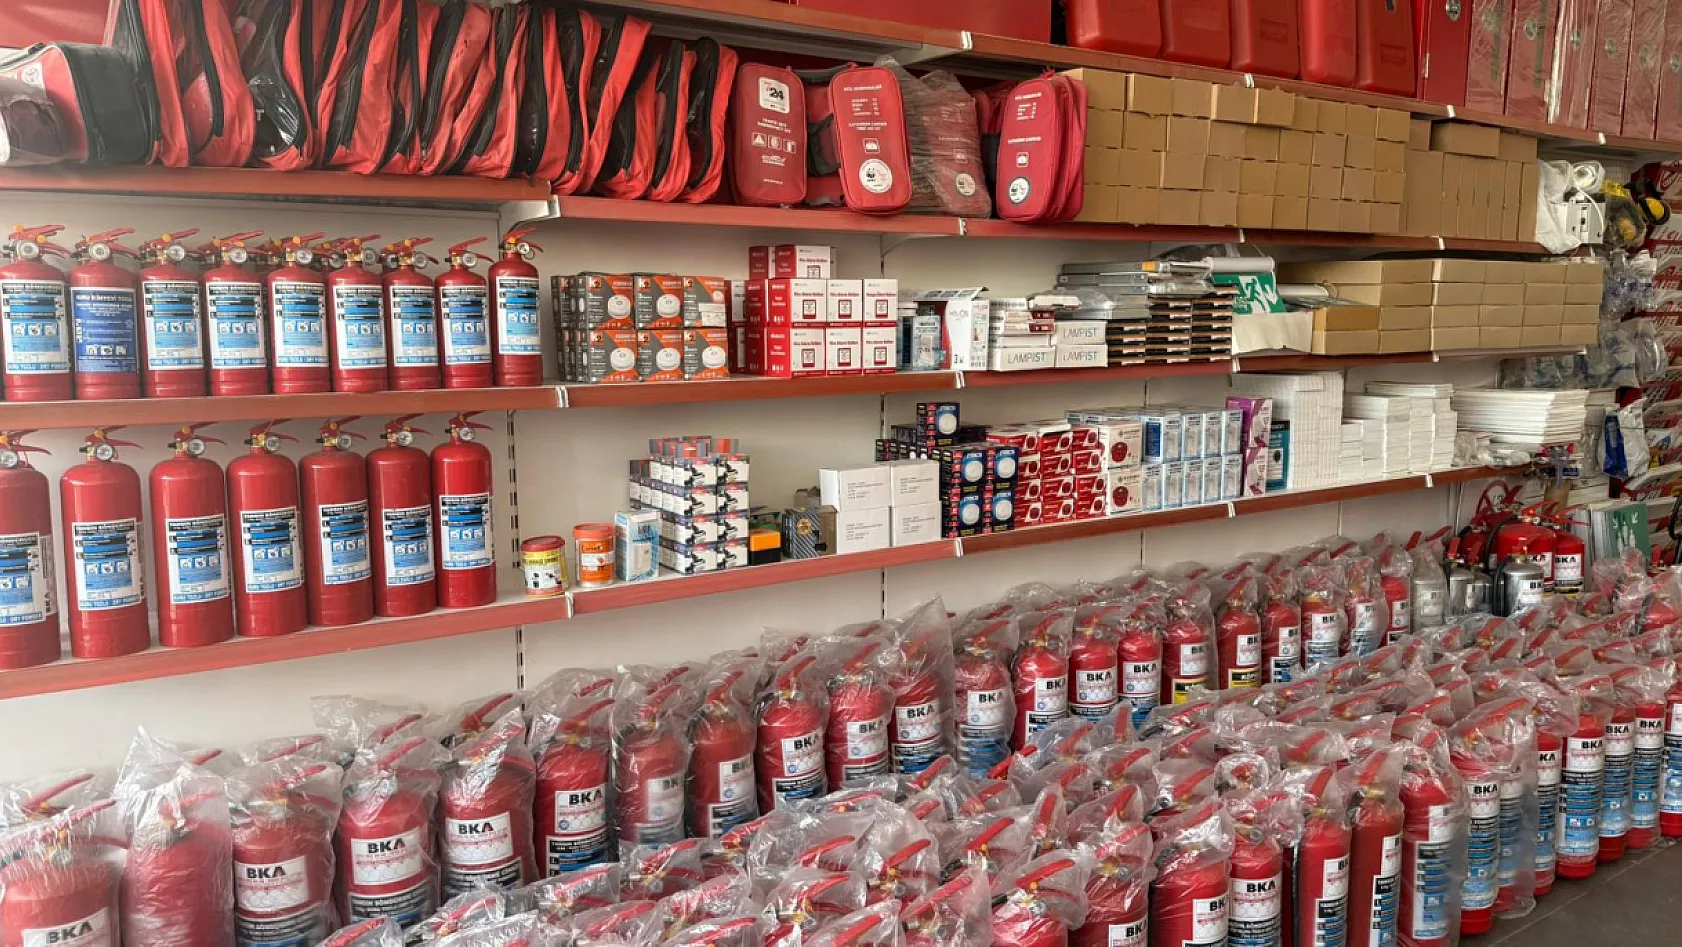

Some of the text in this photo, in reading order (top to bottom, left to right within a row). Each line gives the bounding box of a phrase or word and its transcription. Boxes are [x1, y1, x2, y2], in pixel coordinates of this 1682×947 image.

[1086, 672, 1112, 682] BKA
[907, 704, 935, 718] BKA
[1605, 726, 1629, 734] BKA
[1640, 720, 1661, 728] BKA
[1539, 753, 1556, 762] KA
[1474, 784, 1497, 795] BKA
[568, 787, 603, 805] BKA
[458, 822, 494, 835] BKA
[367, 838, 405, 854] BKA
[246, 866, 286, 879] BKA
[1247, 881, 1276, 892] BKA
[46, 921, 93, 943] BKA
